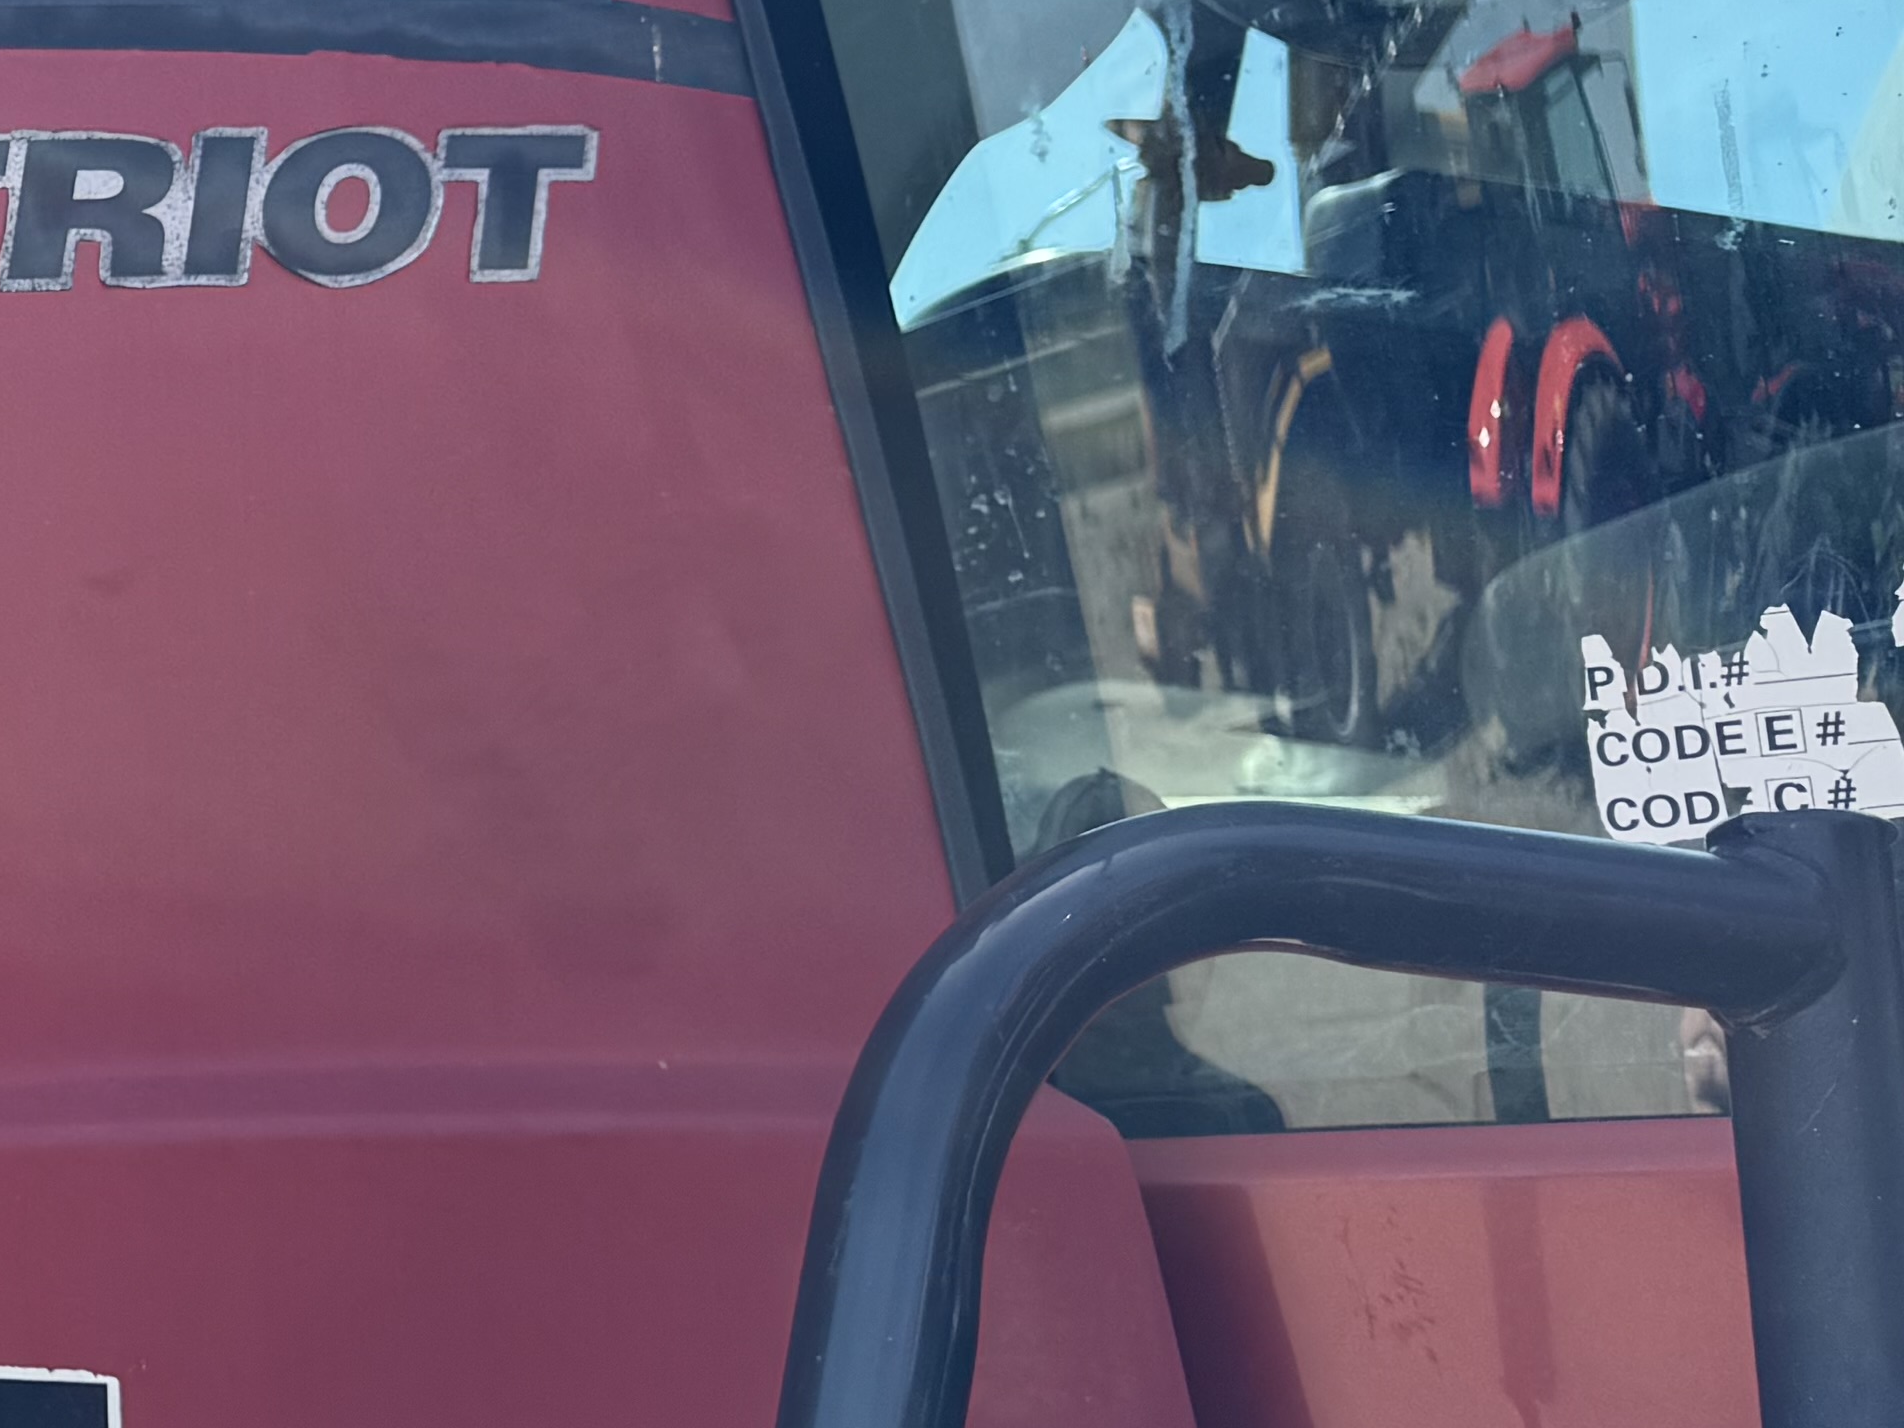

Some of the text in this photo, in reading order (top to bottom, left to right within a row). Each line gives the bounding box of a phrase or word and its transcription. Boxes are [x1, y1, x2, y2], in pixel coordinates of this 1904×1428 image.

[1596, 710, 1846, 767] CODE E #
[1774, 781, 1809, 811] C
[1827, 777, 1857, 810] #
